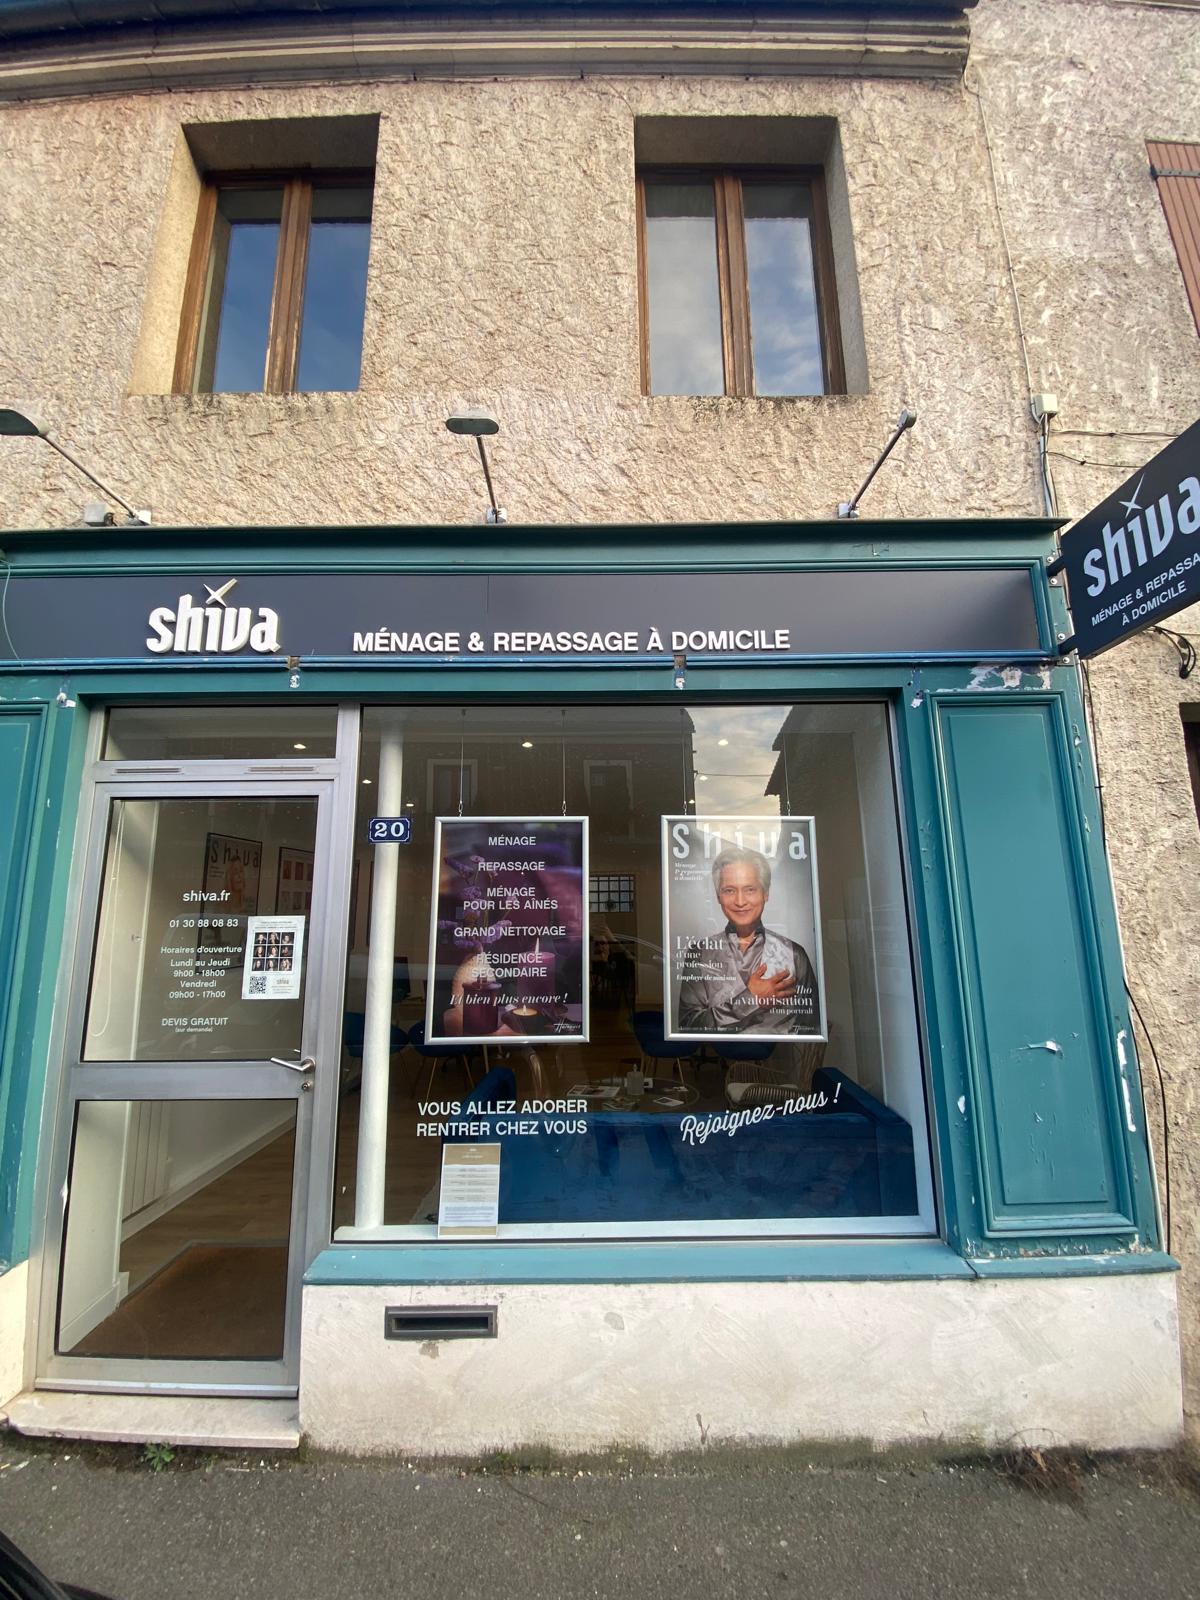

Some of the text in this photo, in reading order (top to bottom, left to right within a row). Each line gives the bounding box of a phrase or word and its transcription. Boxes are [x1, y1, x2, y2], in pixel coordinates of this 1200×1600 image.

[1083, 473, 1200, 597] shiva
[1091, 593, 1134, 627] MÉNAGE
[1135, 588, 1144, 600] &
[1121, 580, 1188, 626] À DOMICILE
[146, 578, 281, 653] shiva
[353, 626, 791, 653] MÉNAGE & REPASSAGE À DOMICILE
[374, 821, 405, 838] 20
[488, 834, 537, 847] MÉNAGE
[478, 861, 545, 872] REPASSAGE
[182, 889, 231, 902] shiva.fr
[487, 885, 536, 897] MÉNAGE
[463, 897, 559, 911] POUR LES AÎNÉS
[169, 918, 239, 928] 01 30 88 08 83
[454, 926, 566, 937] GRAND NETTOYAGE
[160, 945, 243, 954] Horaires d'ouverture
[170, 958, 194, 967] Lundi
[207, 957, 231, 967] Jeudi
[476, 951, 543, 964] RÉSIDENCE
[173, 969, 194, 977] 9h00
[202, 969, 226, 977] 18h00
[471, 967, 548, 978] SECONDAIRE
[180, 979, 217, 988] Vendredi
[169, 991, 195, 999] 09h00
[202, 990, 226, 998] 17h00
[465, 993, 490, 1005] bien
[492, 993, 519, 1007] plus
[521, 995, 561, 1004] encore
[741, 994, 813, 1006] valorisation
[161, 1017, 229, 1026] DEVIS GRATUIT
[418, 1099, 588, 1116] VOUS ALLEZ ADORER
[680, 1082, 842, 1146] Rejoignez-nous !
[416, 1119, 588, 1137] RENTRER CHEZ VOUS
